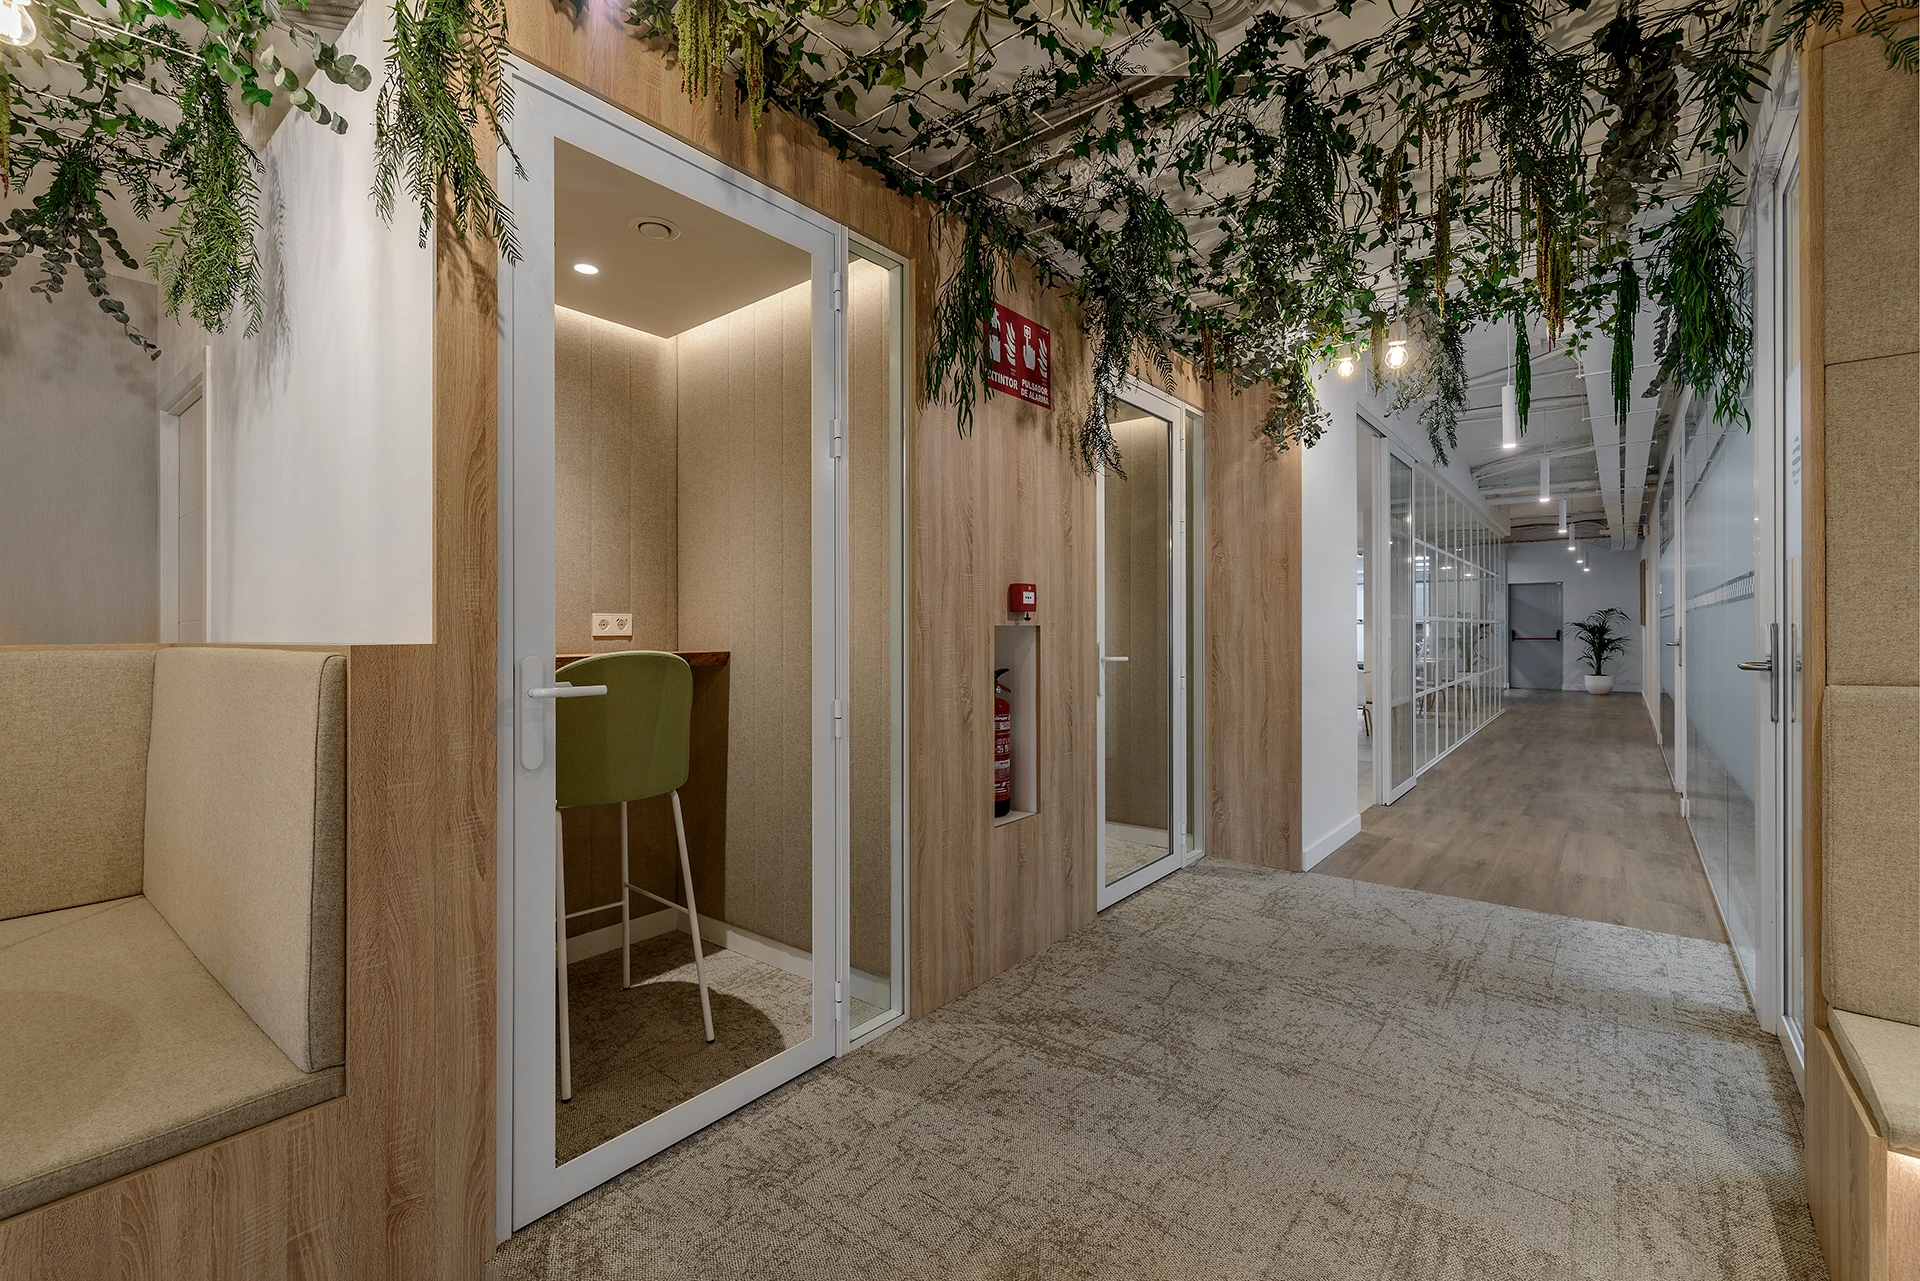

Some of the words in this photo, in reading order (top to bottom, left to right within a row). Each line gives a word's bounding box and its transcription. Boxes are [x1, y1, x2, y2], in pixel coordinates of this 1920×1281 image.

[1022, 378, 1048, 396] PULSADOR
[1020, 388, 1028, 398] DE
[1029, 391, 1049, 405] ALARMA
